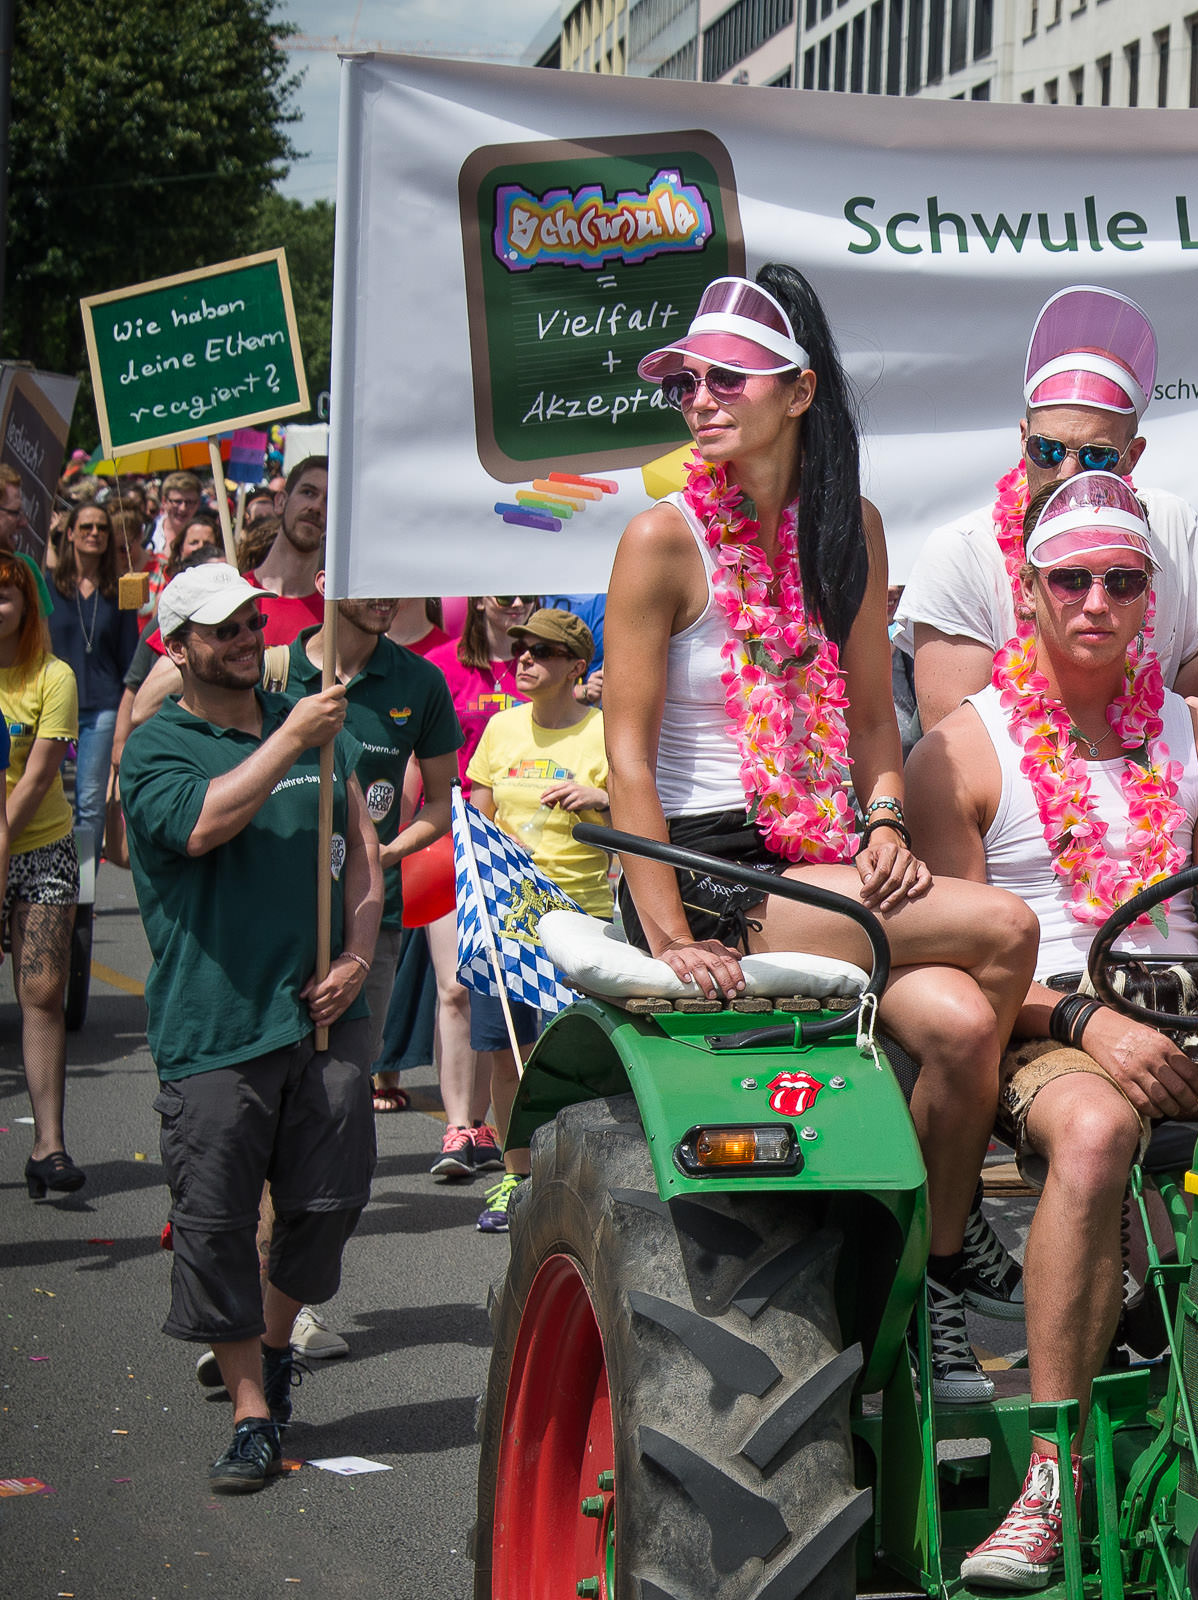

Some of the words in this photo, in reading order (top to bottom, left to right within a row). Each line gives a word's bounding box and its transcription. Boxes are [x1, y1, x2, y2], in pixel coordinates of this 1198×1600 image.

[843, 195, 1147, 254] Schwule
[113, 318, 161, 342] Wie
[171, 299, 245, 327] haben
[537, 301, 679, 340] Vielfalt
[120, 352, 196, 385] deine
[205, 329, 285, 362] Eltern
[362, 741, 400, 756] bayern.de
[373, 785, 394, 795] STOP
